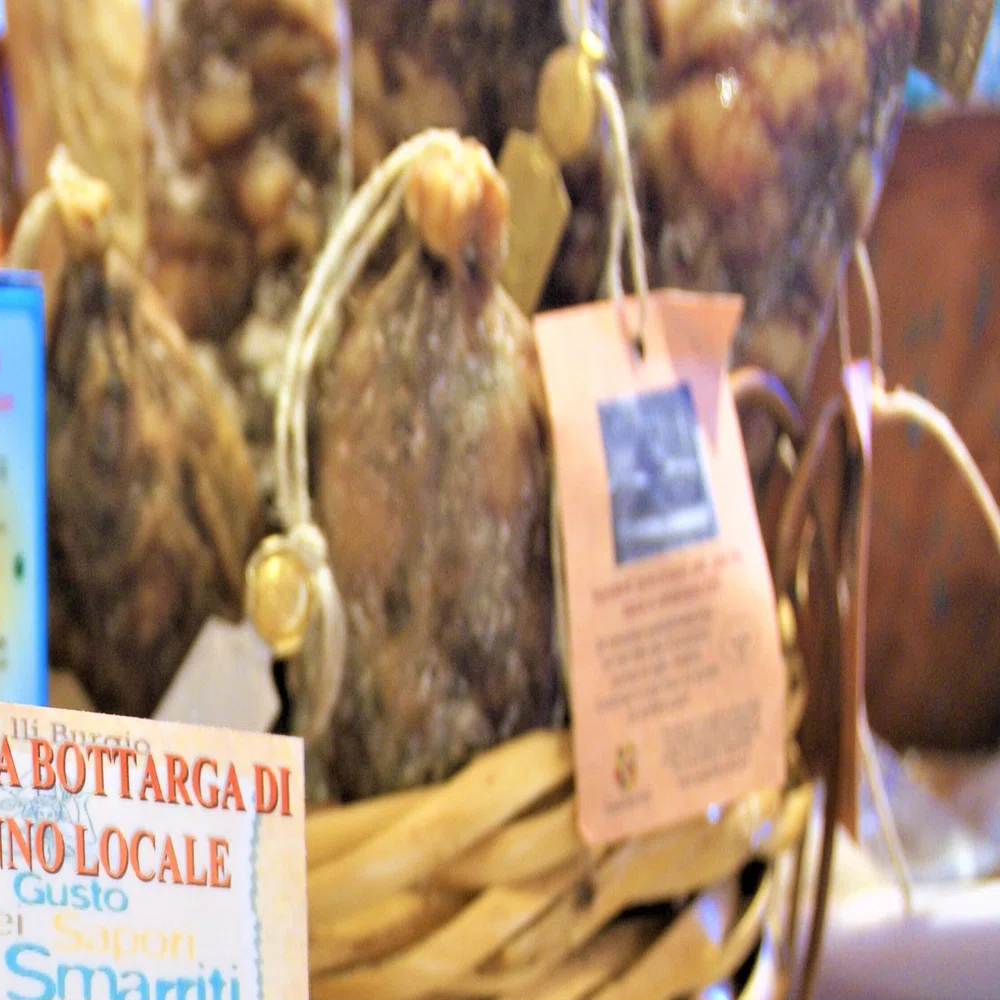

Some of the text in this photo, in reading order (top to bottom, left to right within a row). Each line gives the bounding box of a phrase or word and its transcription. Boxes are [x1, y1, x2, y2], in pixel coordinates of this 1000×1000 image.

[51, 722, 150, 756] Burgio
[30, 737, 246, 812] BOTTARGA
[253, 763, 292, 816] DI
[76, 825, 232, 888] LOCALE
[13, 871, 129, 912] Gusto
[53, 911, 195, 961] Sapori
